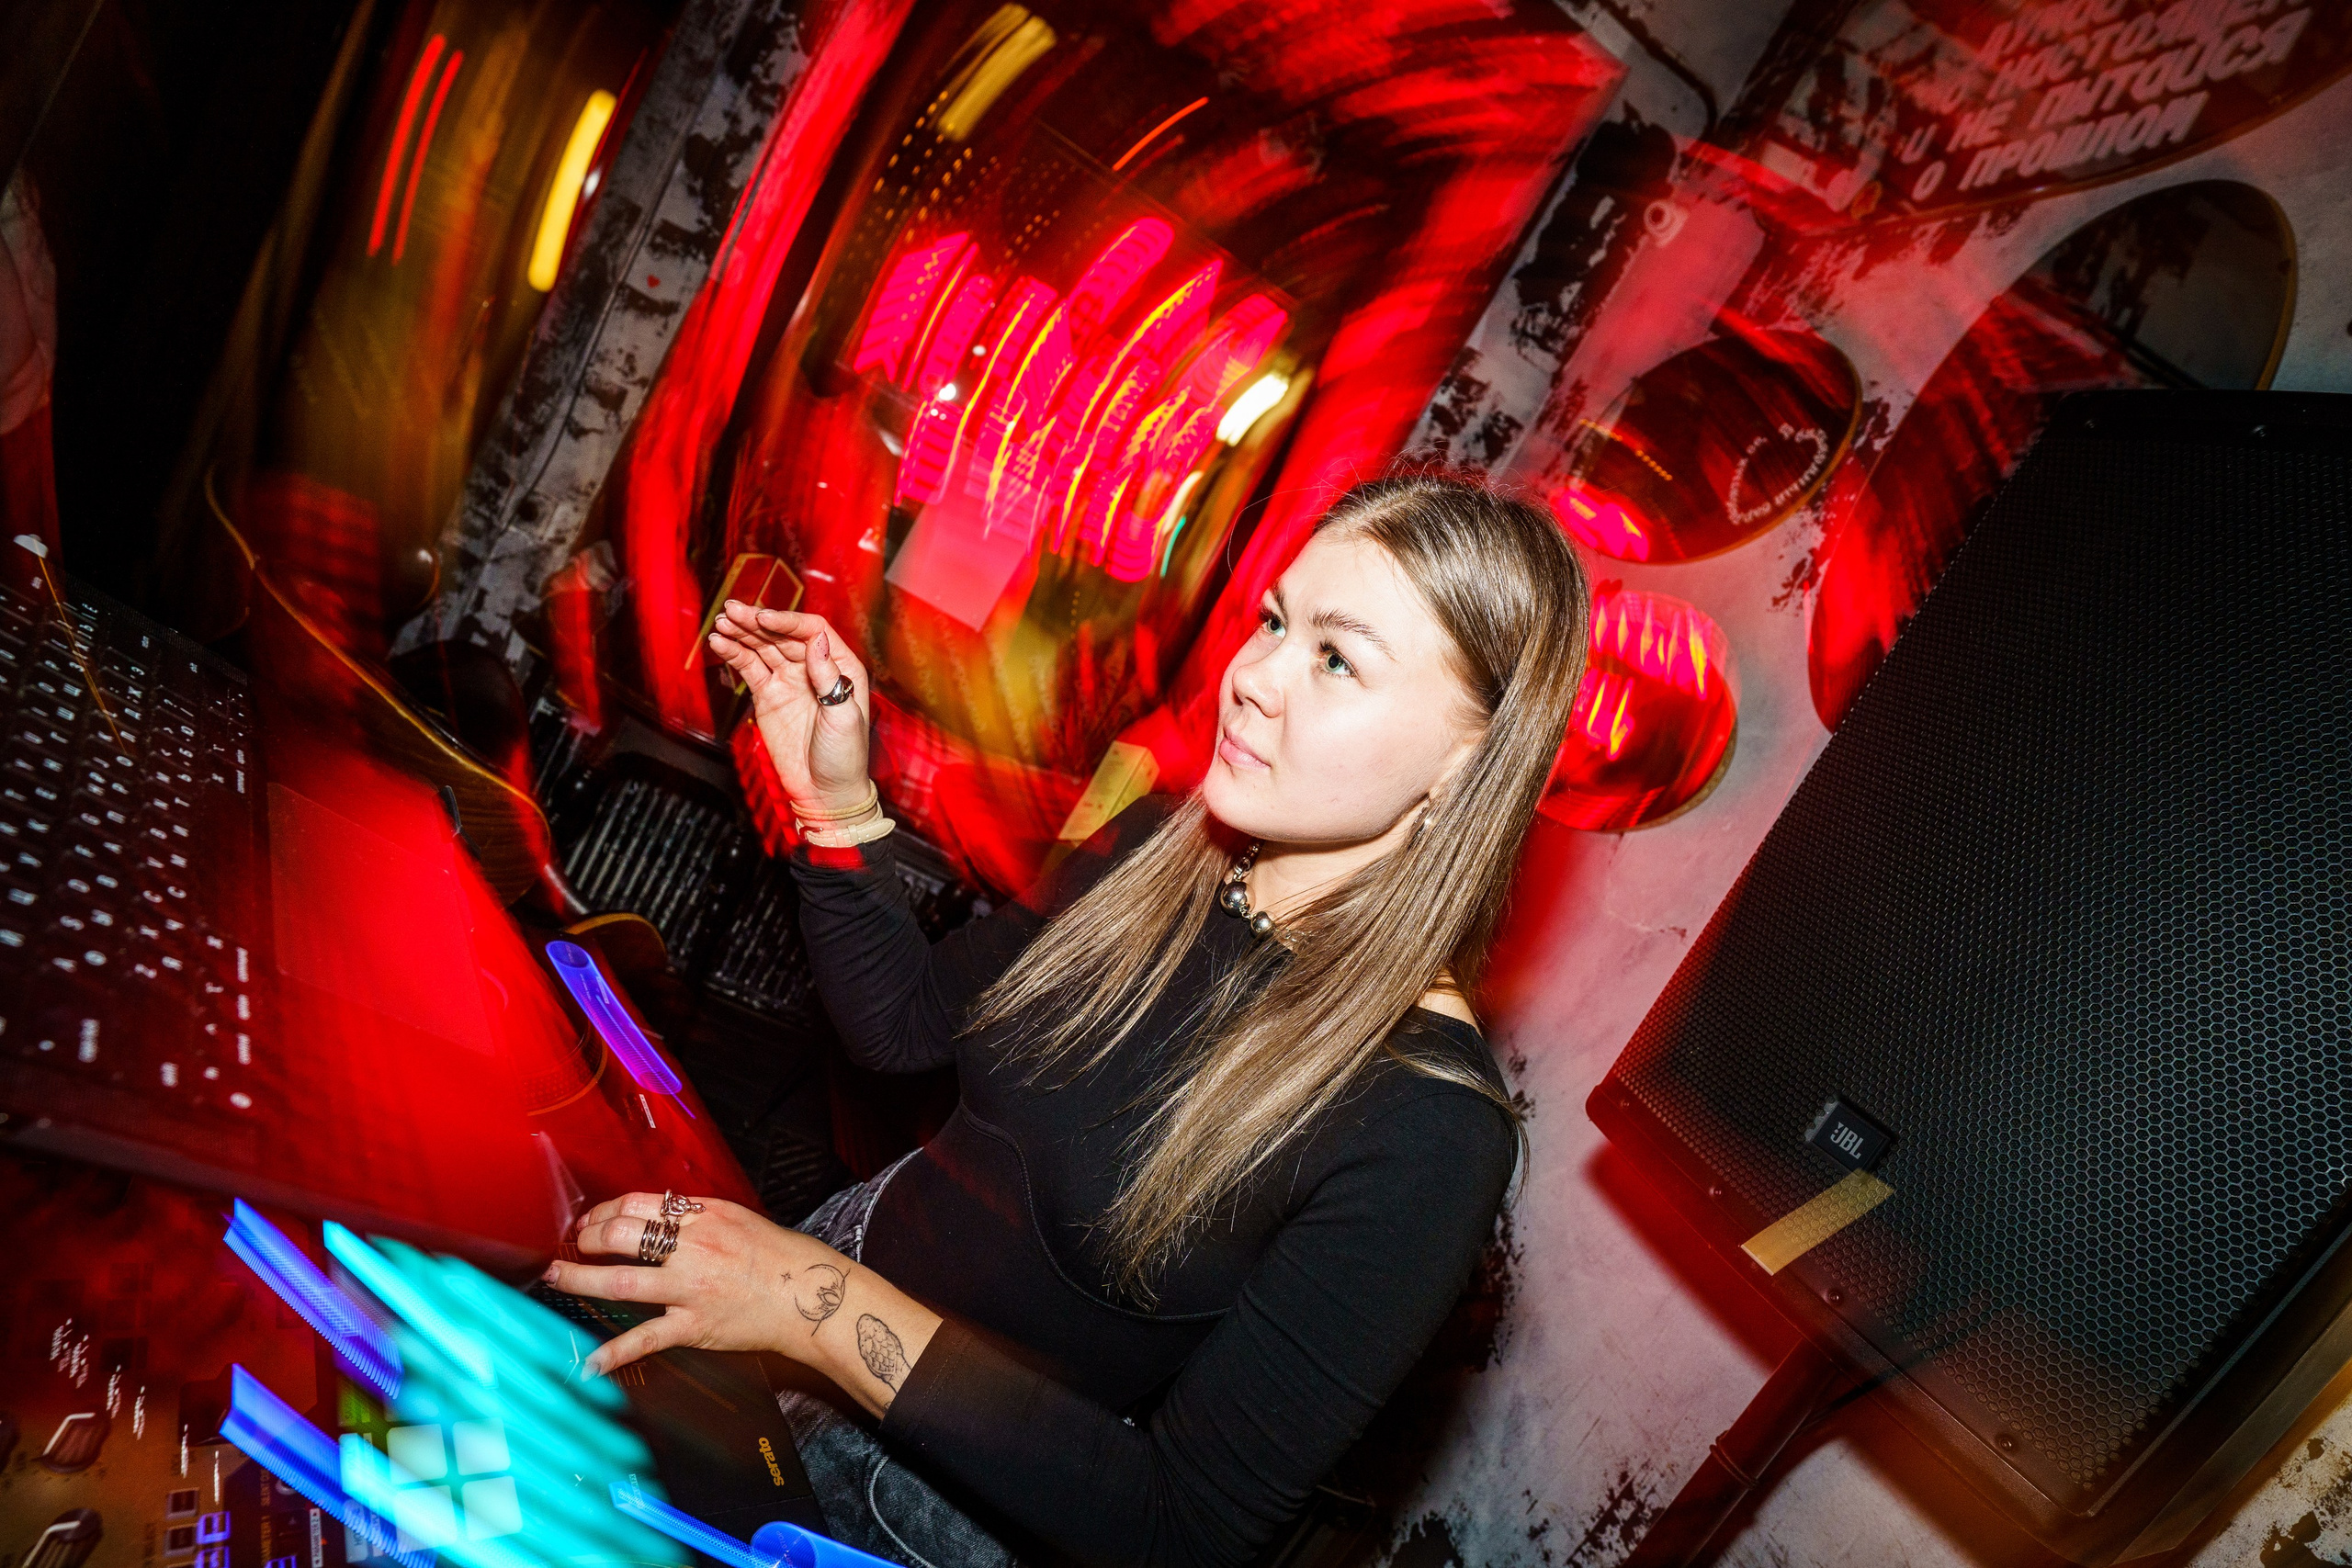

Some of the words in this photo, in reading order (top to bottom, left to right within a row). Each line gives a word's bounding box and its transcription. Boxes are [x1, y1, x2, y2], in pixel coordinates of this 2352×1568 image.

[1911, 160, 1947, 201] О
[1957, 89, 2211, 191] ПРОШЛОМ
[1946, 99, 2018, 153] НЕ
[1830, 1122, 1864, 1159] JBL
[758, 1437, 785, 1486] serato
